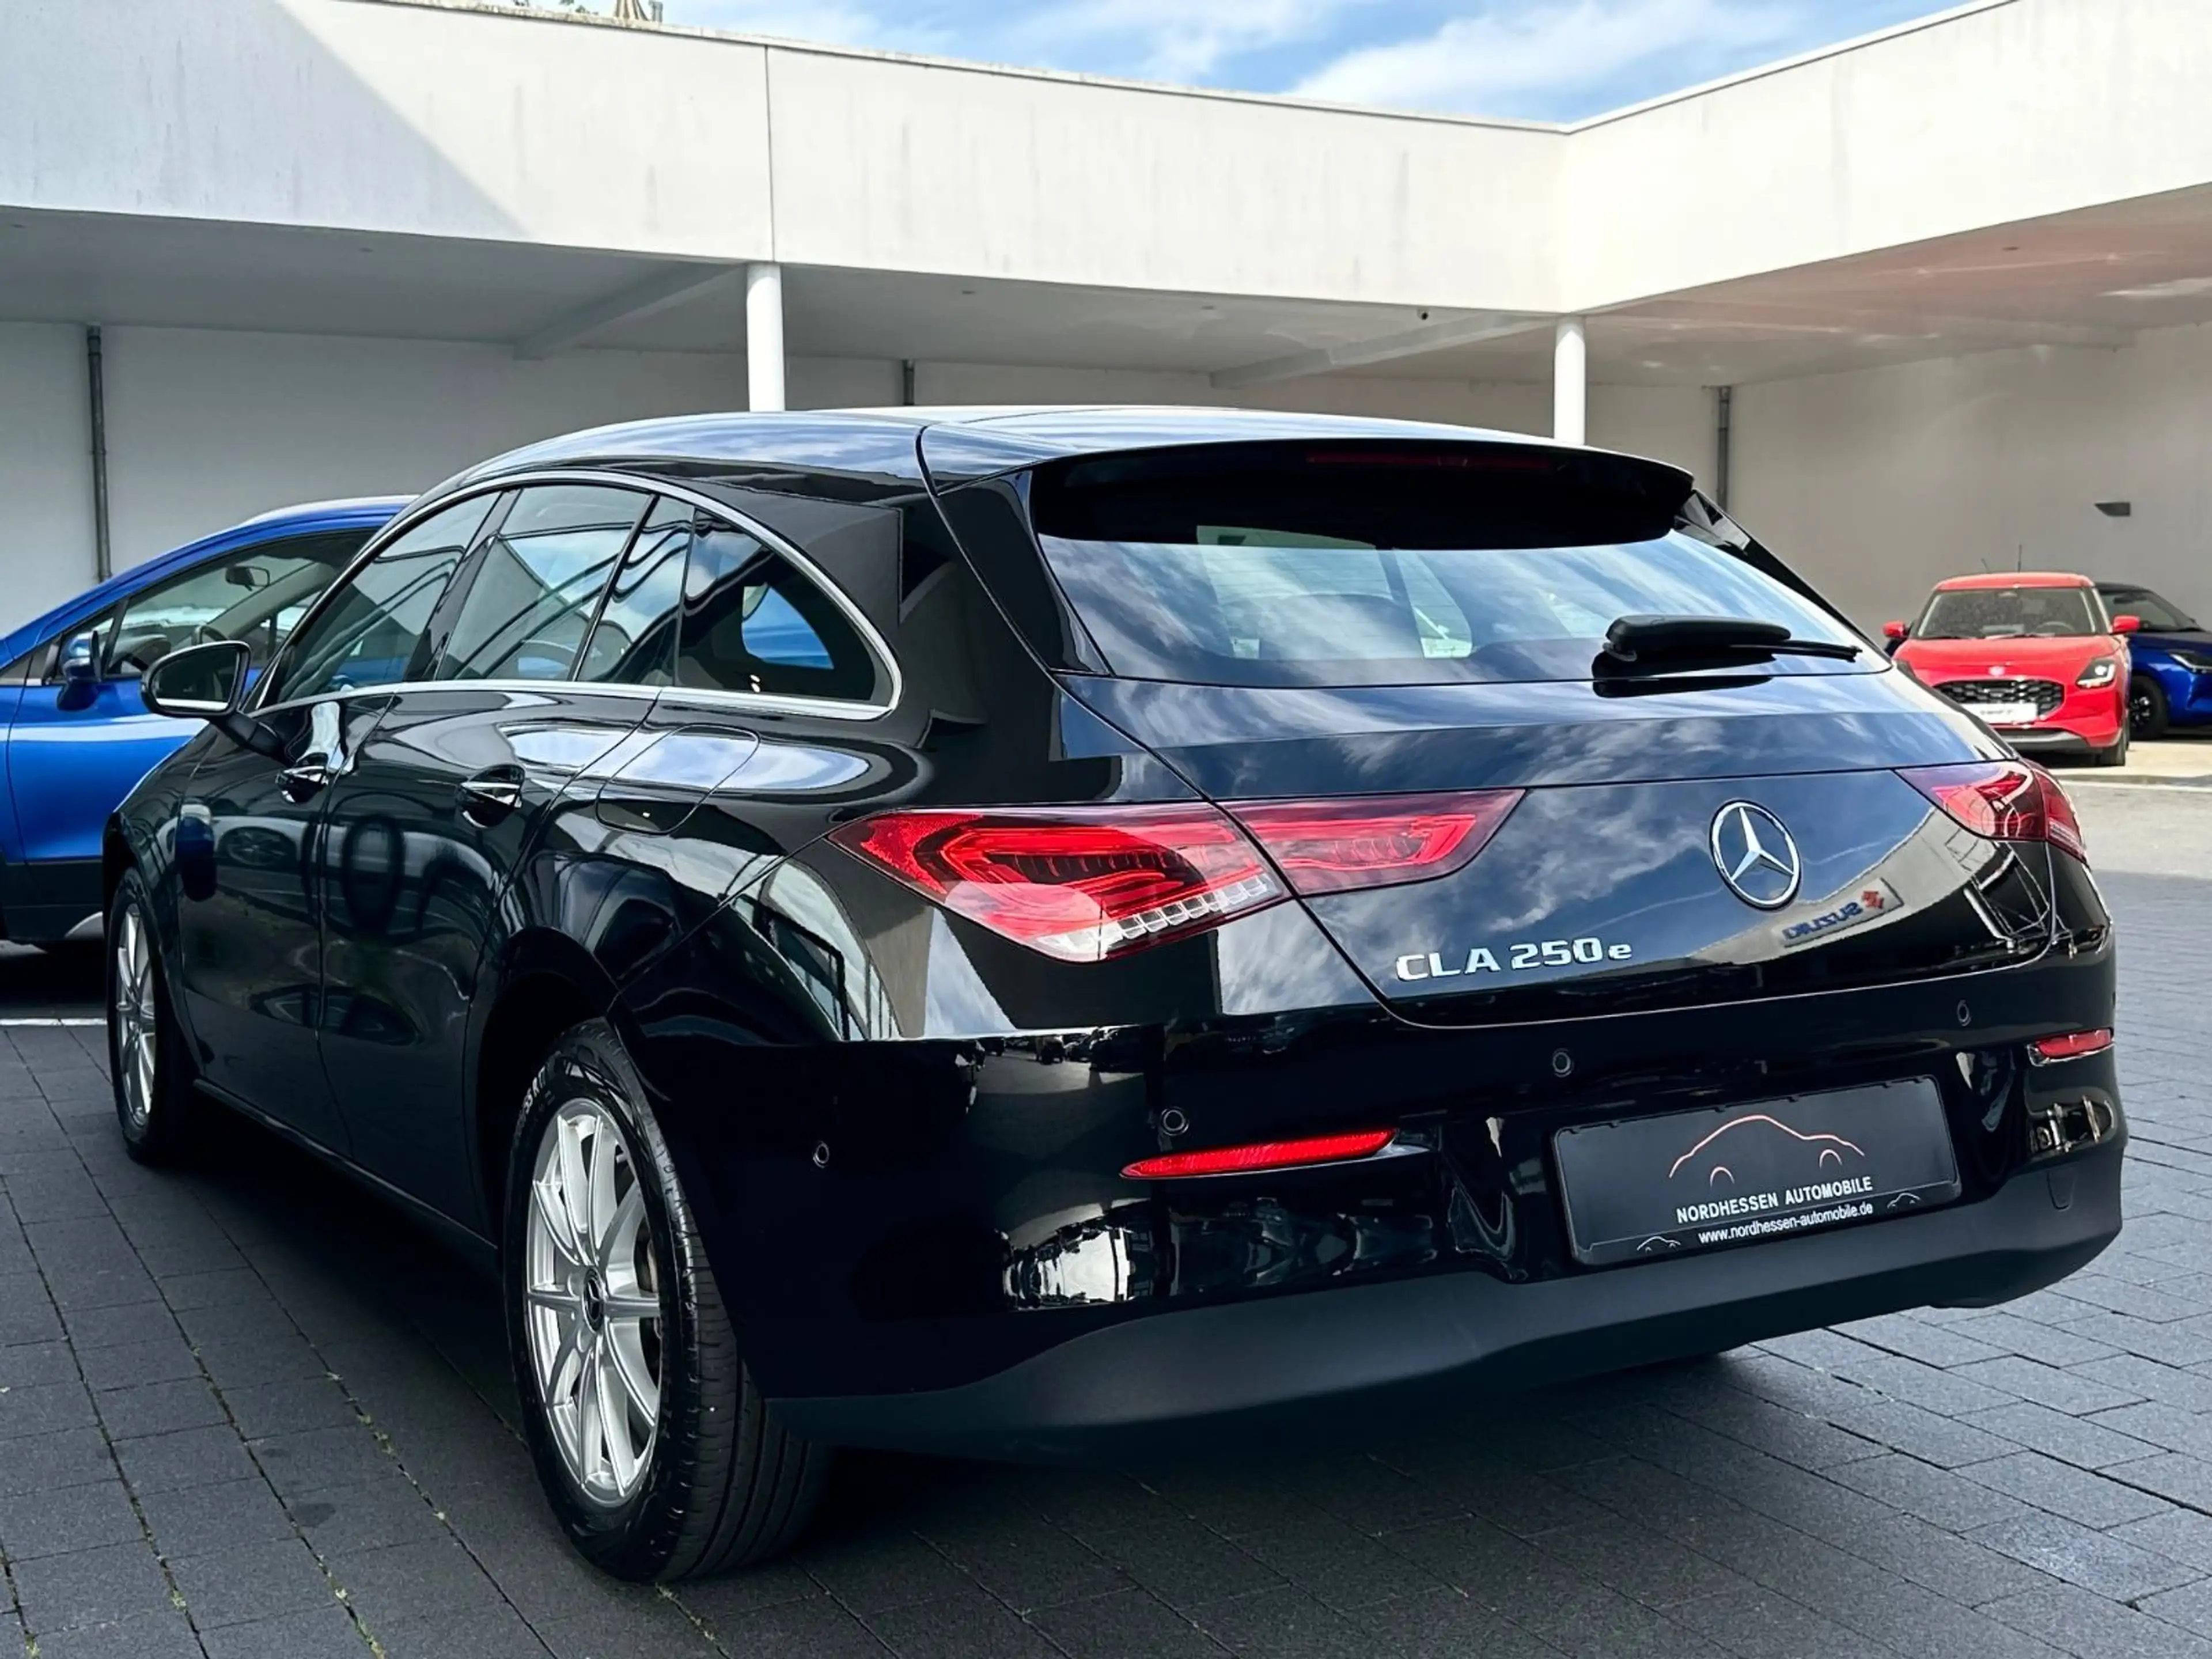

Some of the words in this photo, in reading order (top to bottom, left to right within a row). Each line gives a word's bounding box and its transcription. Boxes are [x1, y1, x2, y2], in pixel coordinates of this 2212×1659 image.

[1395, 948, 1501, 982] CLA
[1677, 1192, 1779, 1224] NORDHESSEN
[1785, 1176, 1873, 1206] AUTOMOBILE
[1699, 1202, 1873, 1244] www.nordhessen-automobile.de
